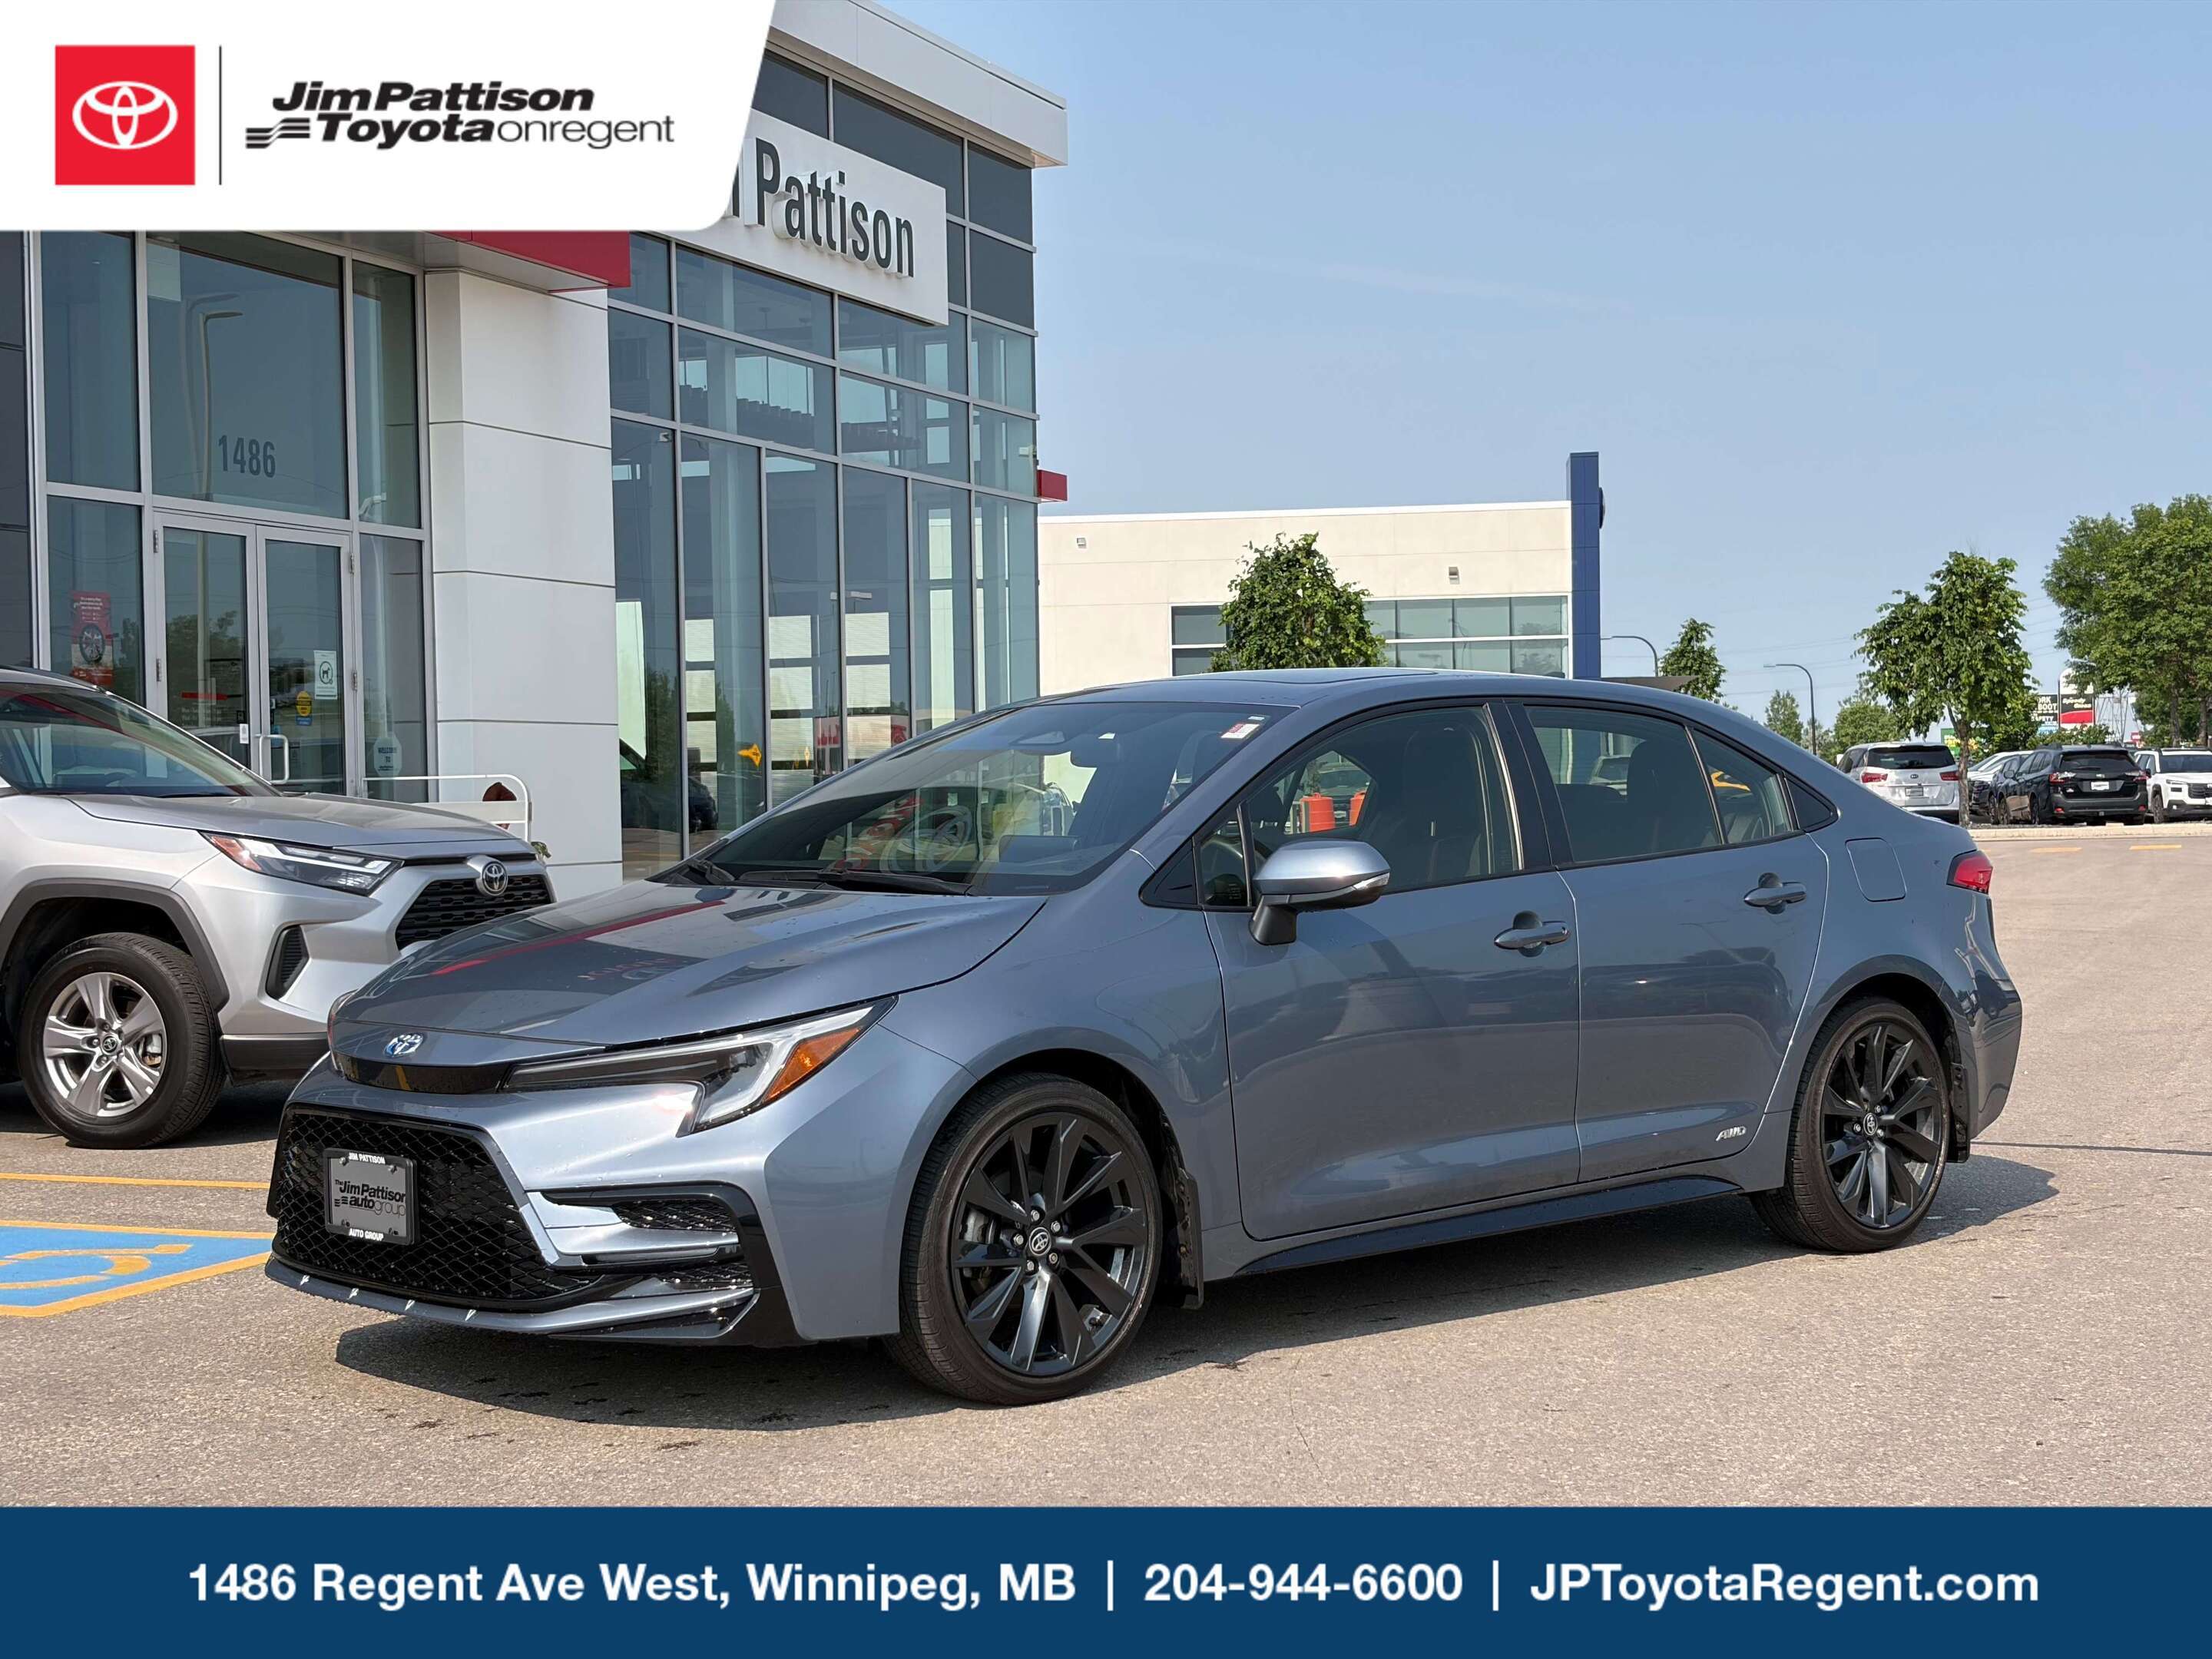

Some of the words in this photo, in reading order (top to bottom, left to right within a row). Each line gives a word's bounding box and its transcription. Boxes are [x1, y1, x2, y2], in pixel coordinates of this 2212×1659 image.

[756, 137, 914, 278] Pattison
[219, 435, 276, 478] 1486
[349, 1152, 359, 1161] JIM
[359, 1154, 386, 1164] PATTISON
[349, 1228, 364, 1238] AUTO
[365, 1230, 384, 1241] GROUP
